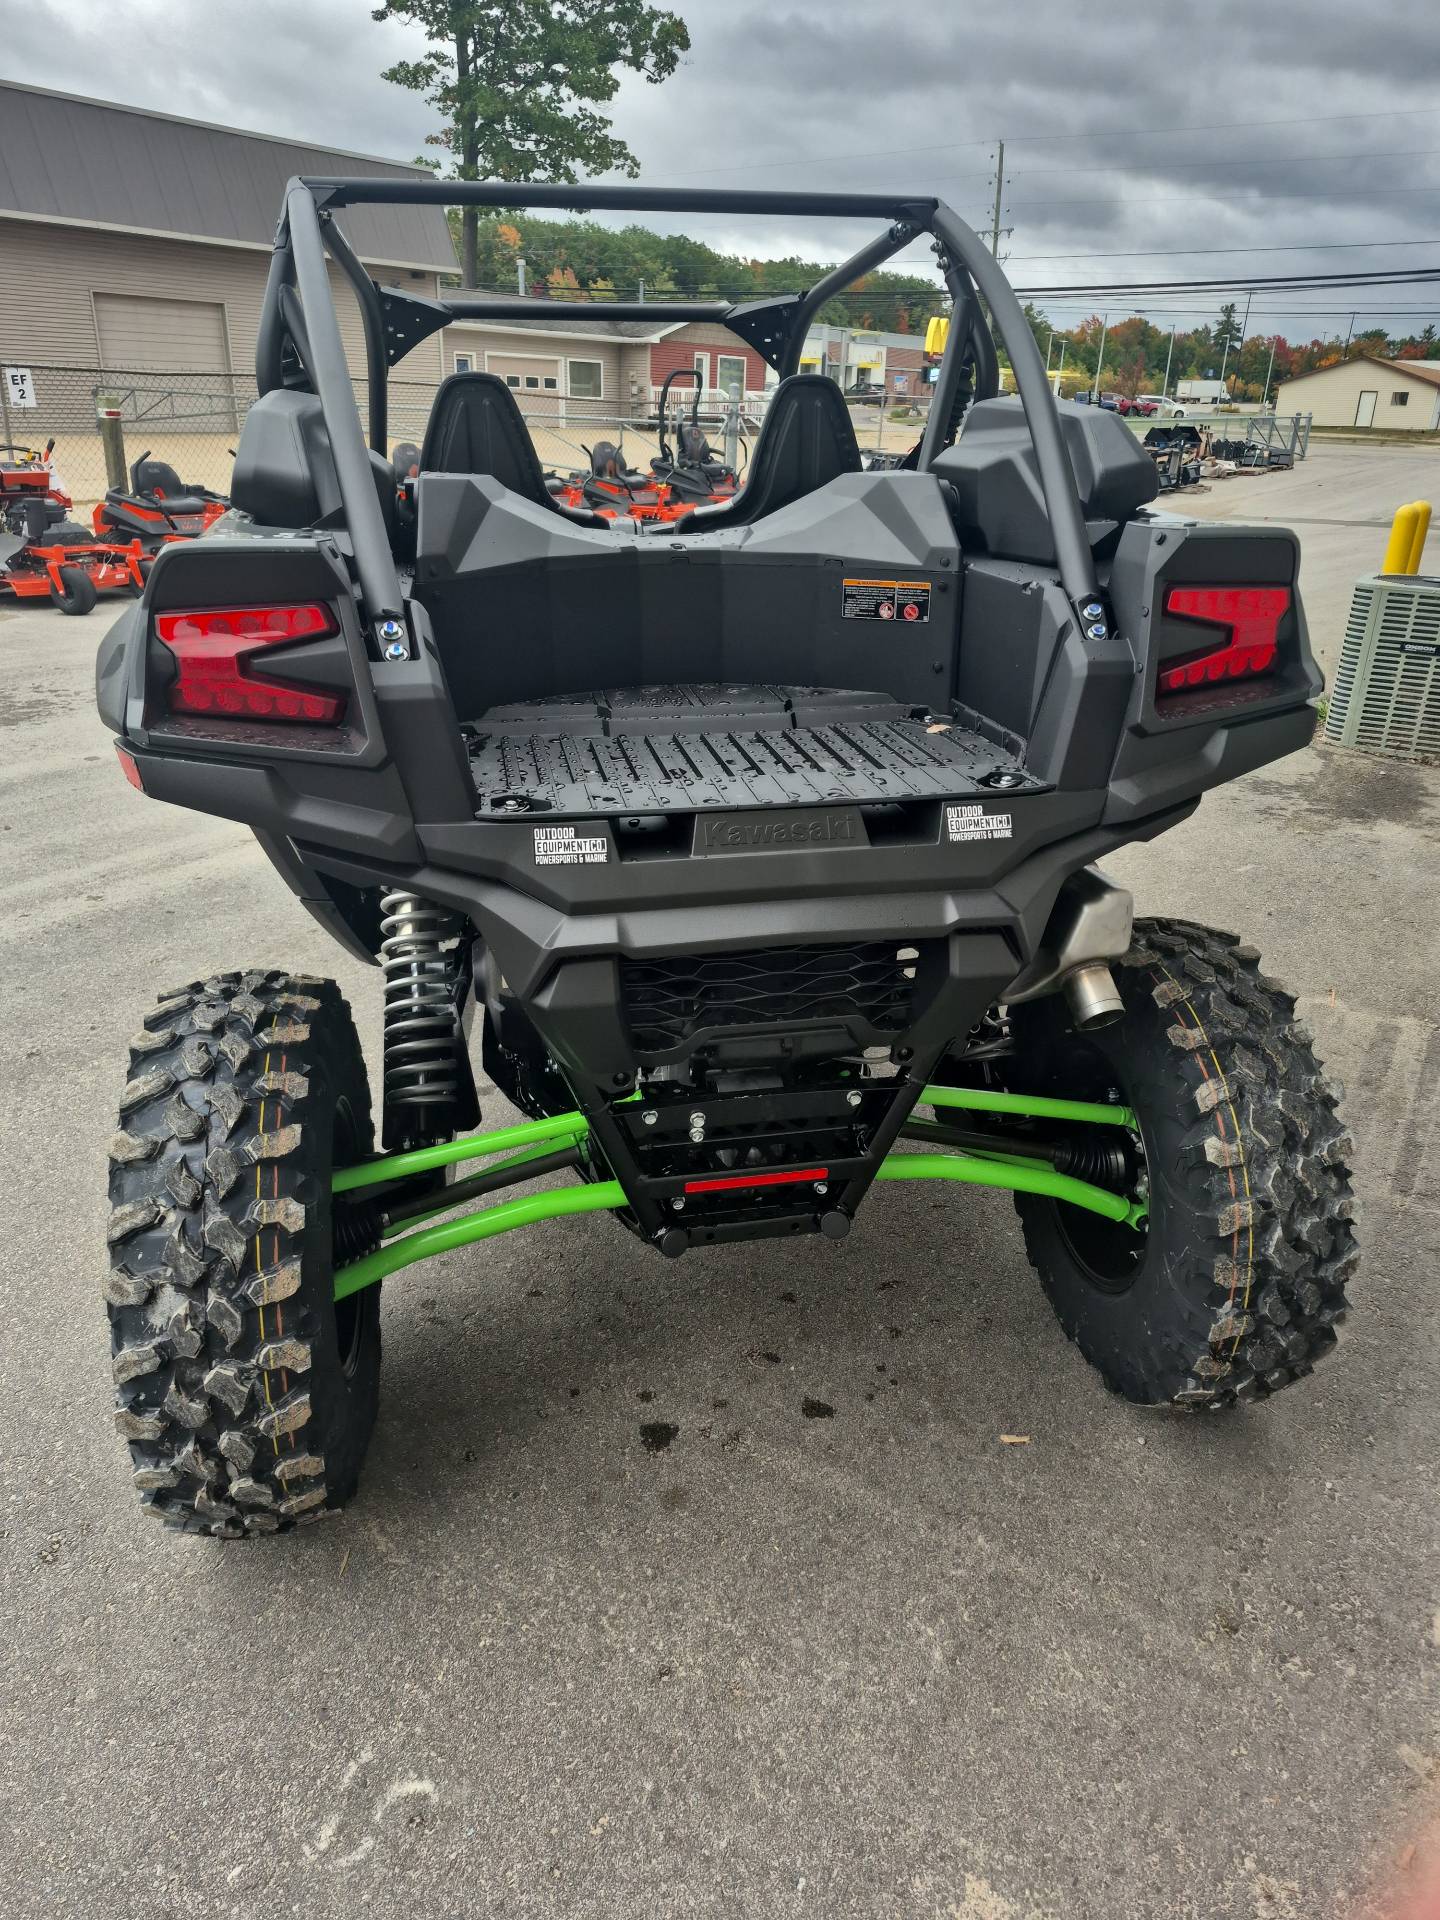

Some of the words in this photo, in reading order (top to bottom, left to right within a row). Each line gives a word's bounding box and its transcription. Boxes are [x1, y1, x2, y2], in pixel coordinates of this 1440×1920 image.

[11, 374, 27, 386] EF
[18, 388, 27, 400] 2
[946, 805, 983, 818] OUTDOOR
[949, 817, 995, 831] EQUIPMENT
[533, 827, 575, 840] OUTDOOR
[704, 815, 856, 847] Kawasaki
[949, 830, 987, 842] POWERSPORTS
[987, 830, 992, 839] &
[992, 828, 1013, 839] MARINE
[536, 840, 588, 853] EQUIPMENT
[535, 854, 578, 865] POWERSPORTS
[578, 854, 584, 863] &
[585, 853, 608, 863] MARINE
